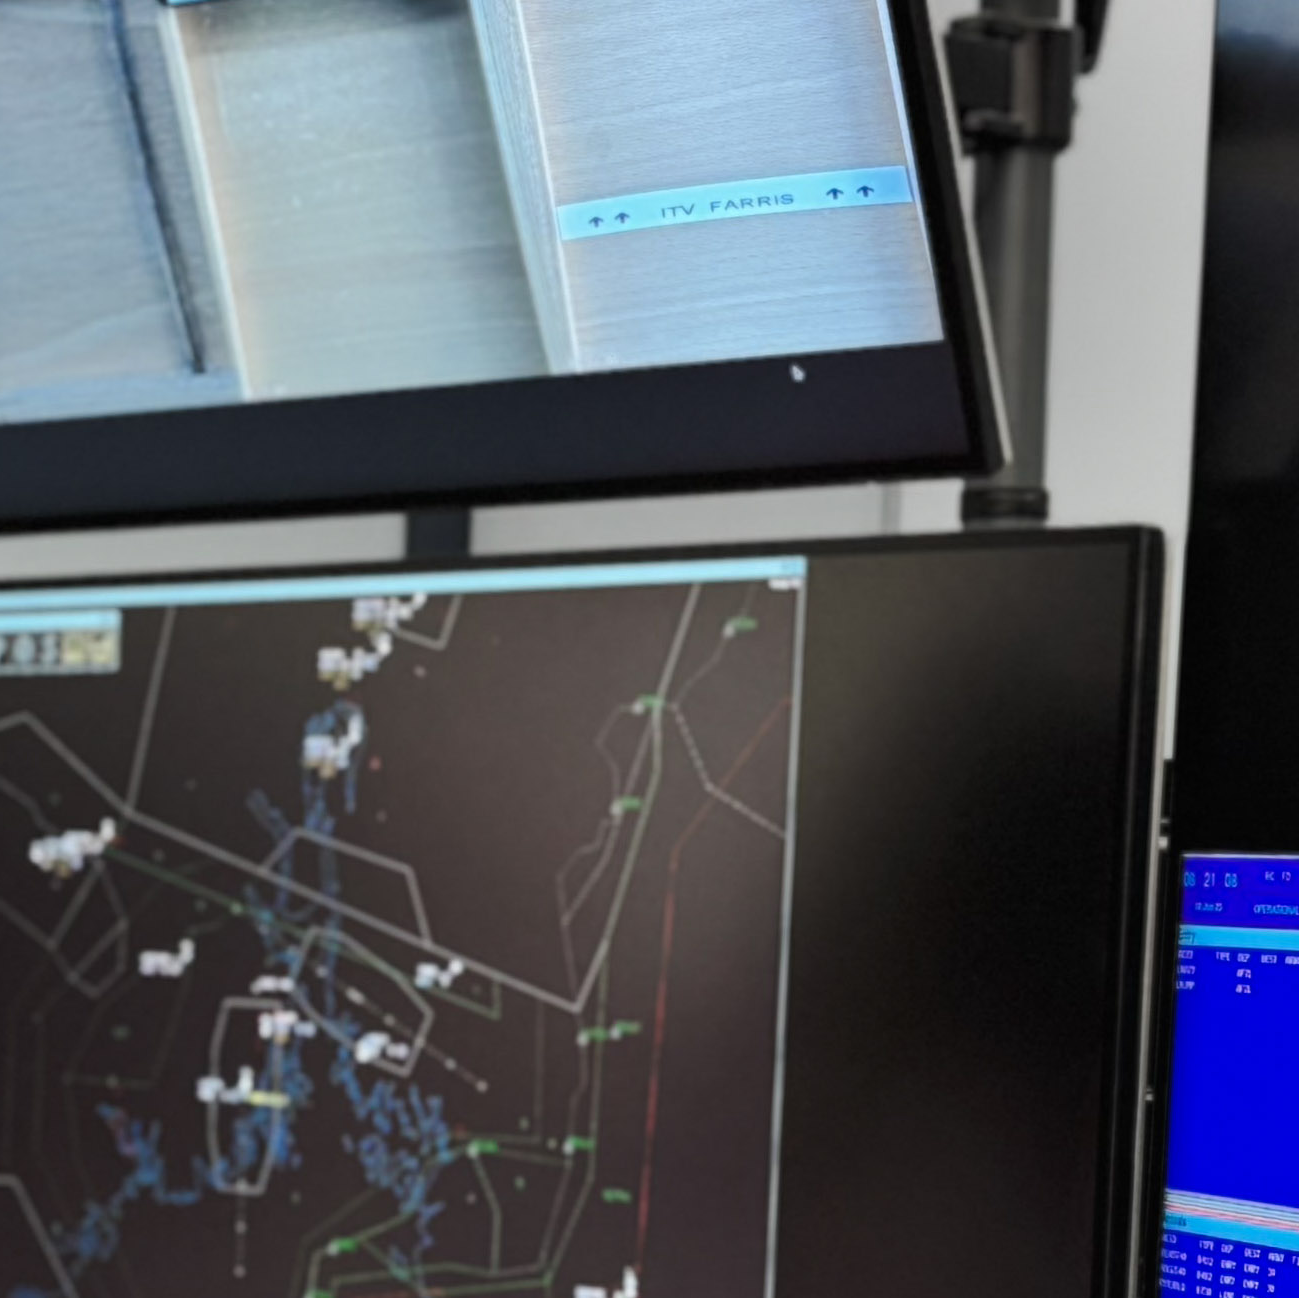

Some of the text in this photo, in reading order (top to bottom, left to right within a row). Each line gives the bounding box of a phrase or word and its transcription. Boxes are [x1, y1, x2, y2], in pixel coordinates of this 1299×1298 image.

[661, 193, 795, 219] ITV FARRIS
[1204, 872, 1215, 887] 21
